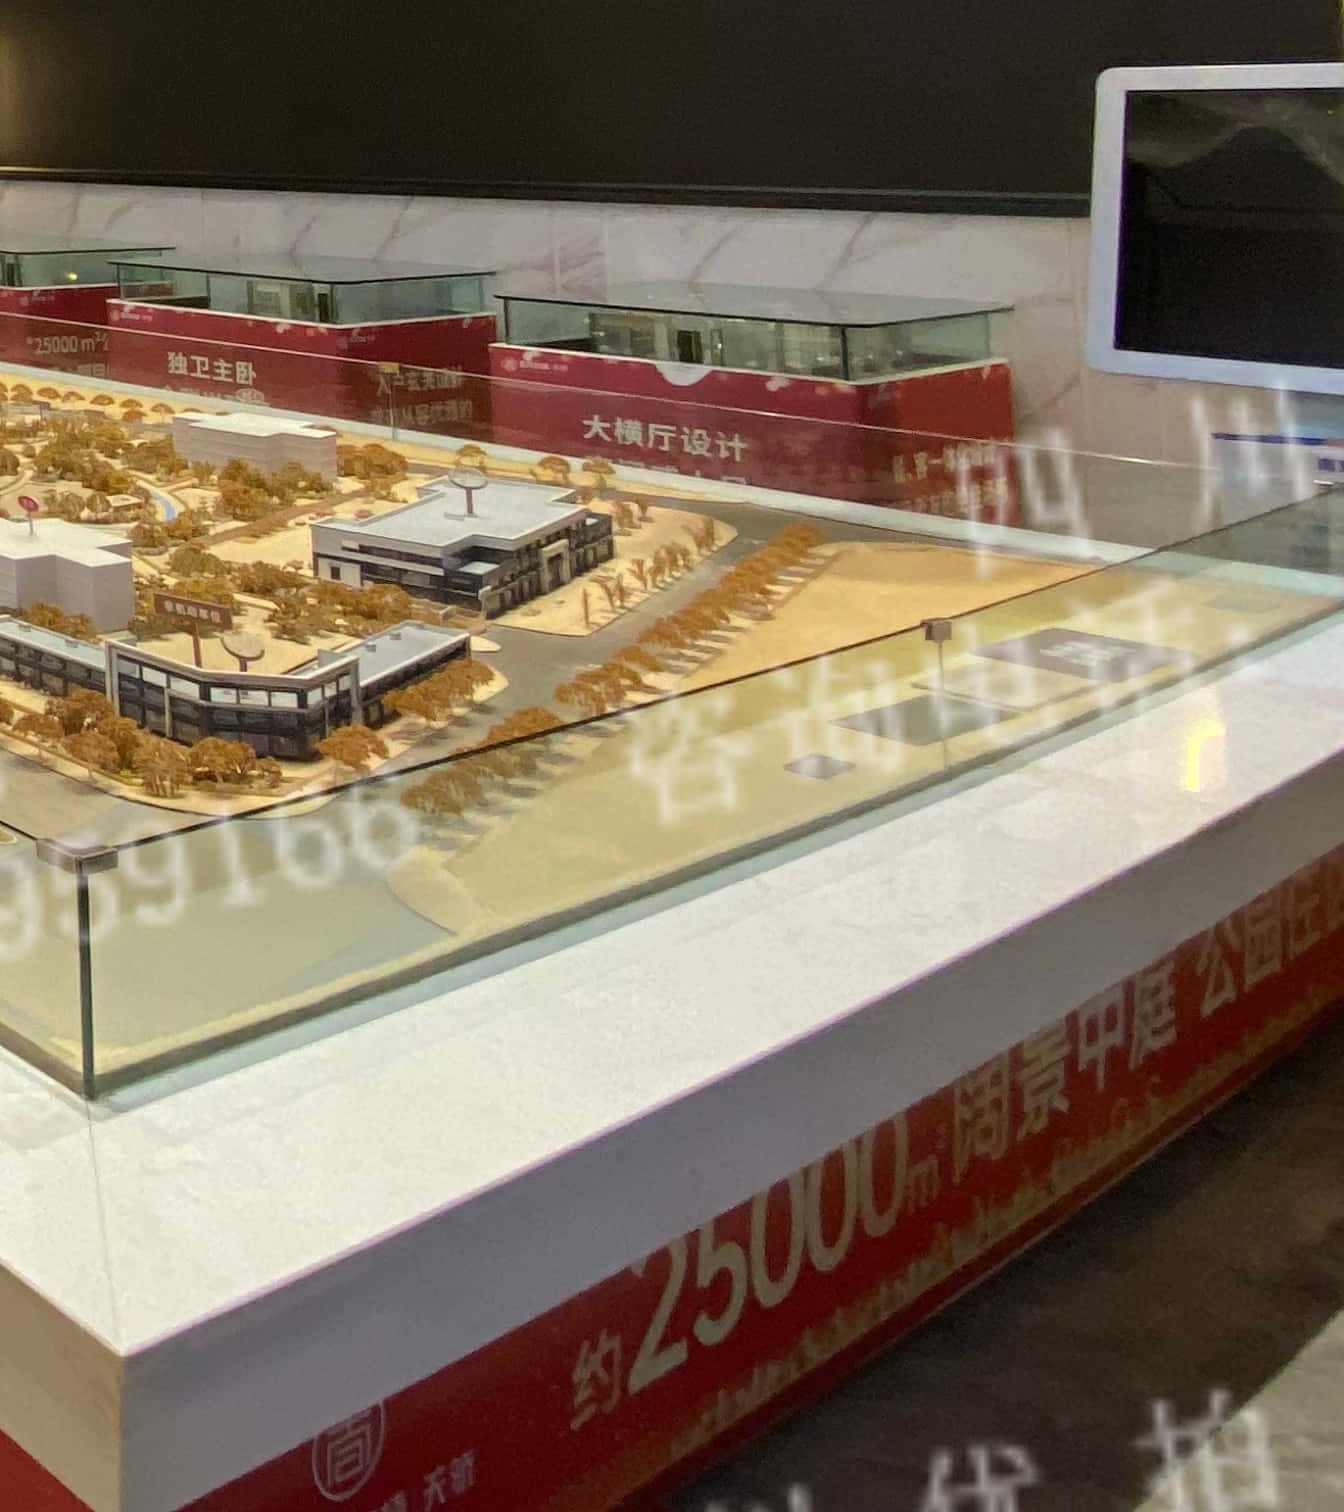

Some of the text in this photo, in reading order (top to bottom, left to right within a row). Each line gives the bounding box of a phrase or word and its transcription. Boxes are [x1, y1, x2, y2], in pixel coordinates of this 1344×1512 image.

[167, 350, 257, 387] 独卫主卧
[582, 413, 749, 463] 大横厅设计
